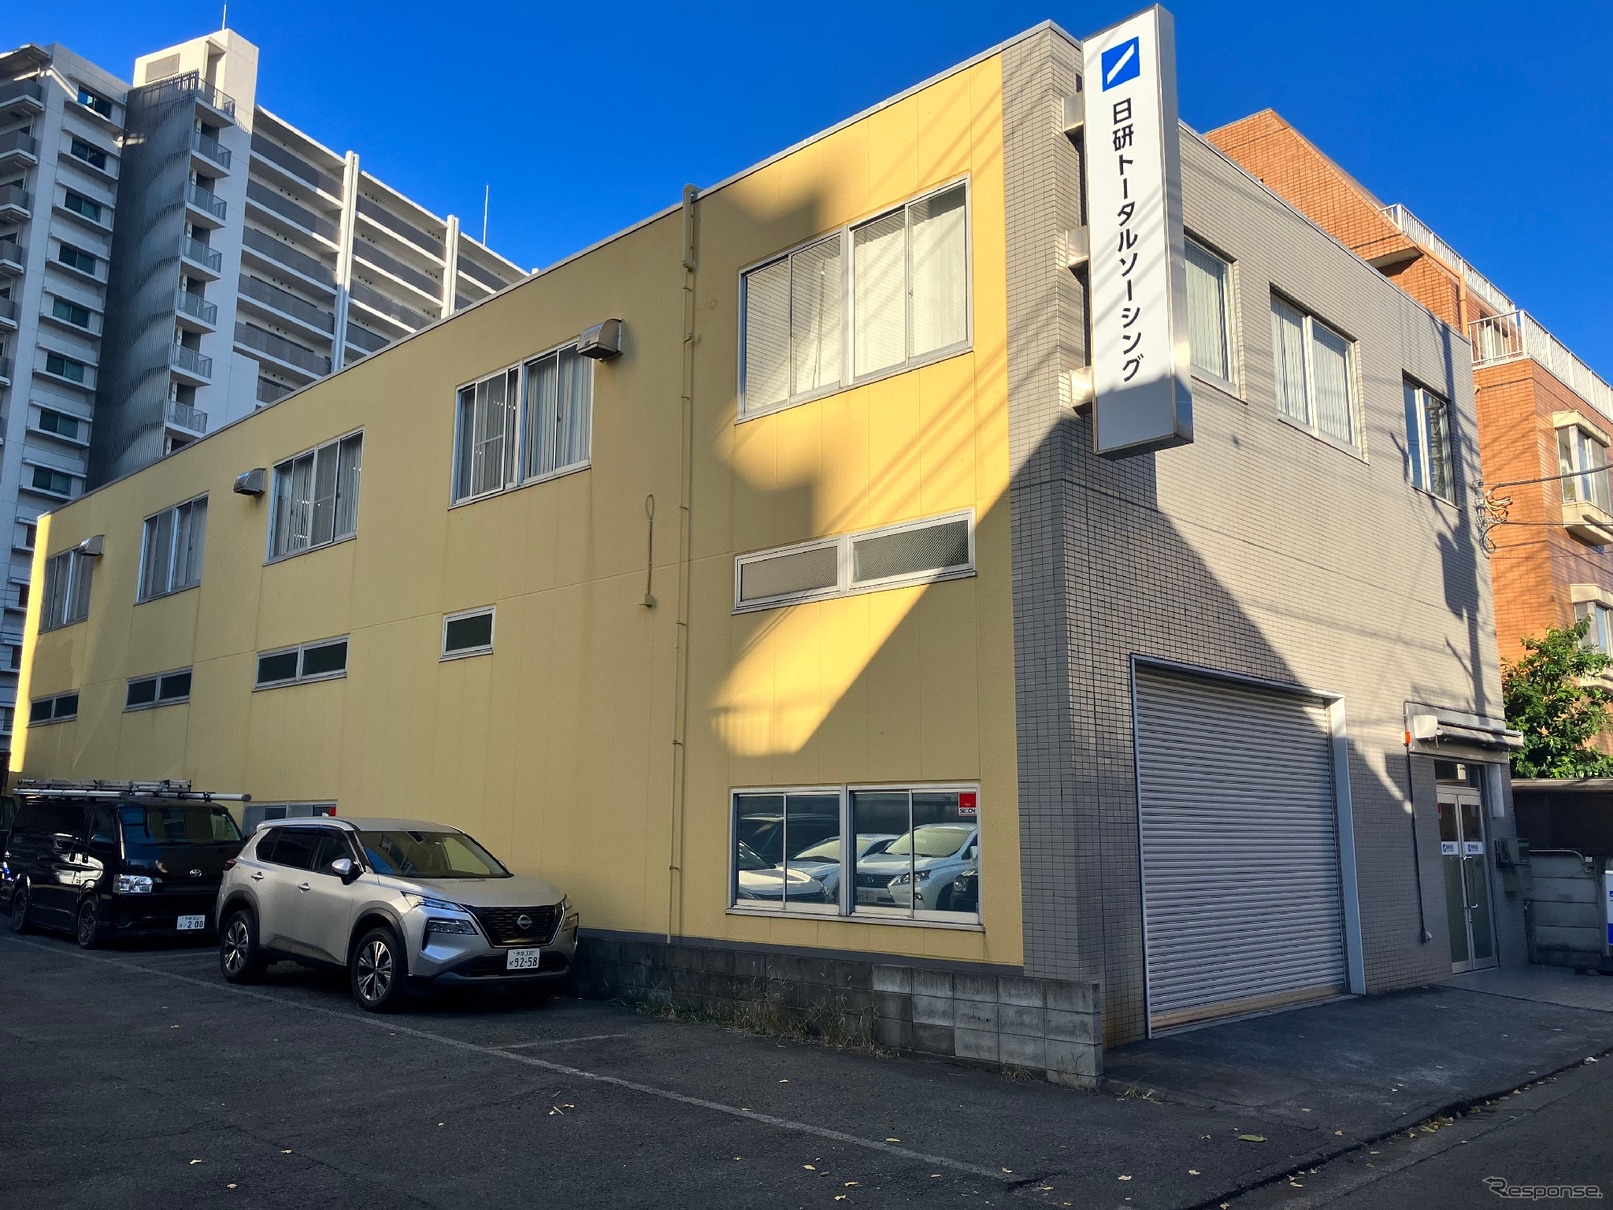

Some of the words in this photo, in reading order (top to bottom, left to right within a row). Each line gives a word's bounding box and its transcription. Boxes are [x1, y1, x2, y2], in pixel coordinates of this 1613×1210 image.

[1112, 97, 1145, 383] 日研トータルソーシング
[514, 956, 538, 968] 92-58
